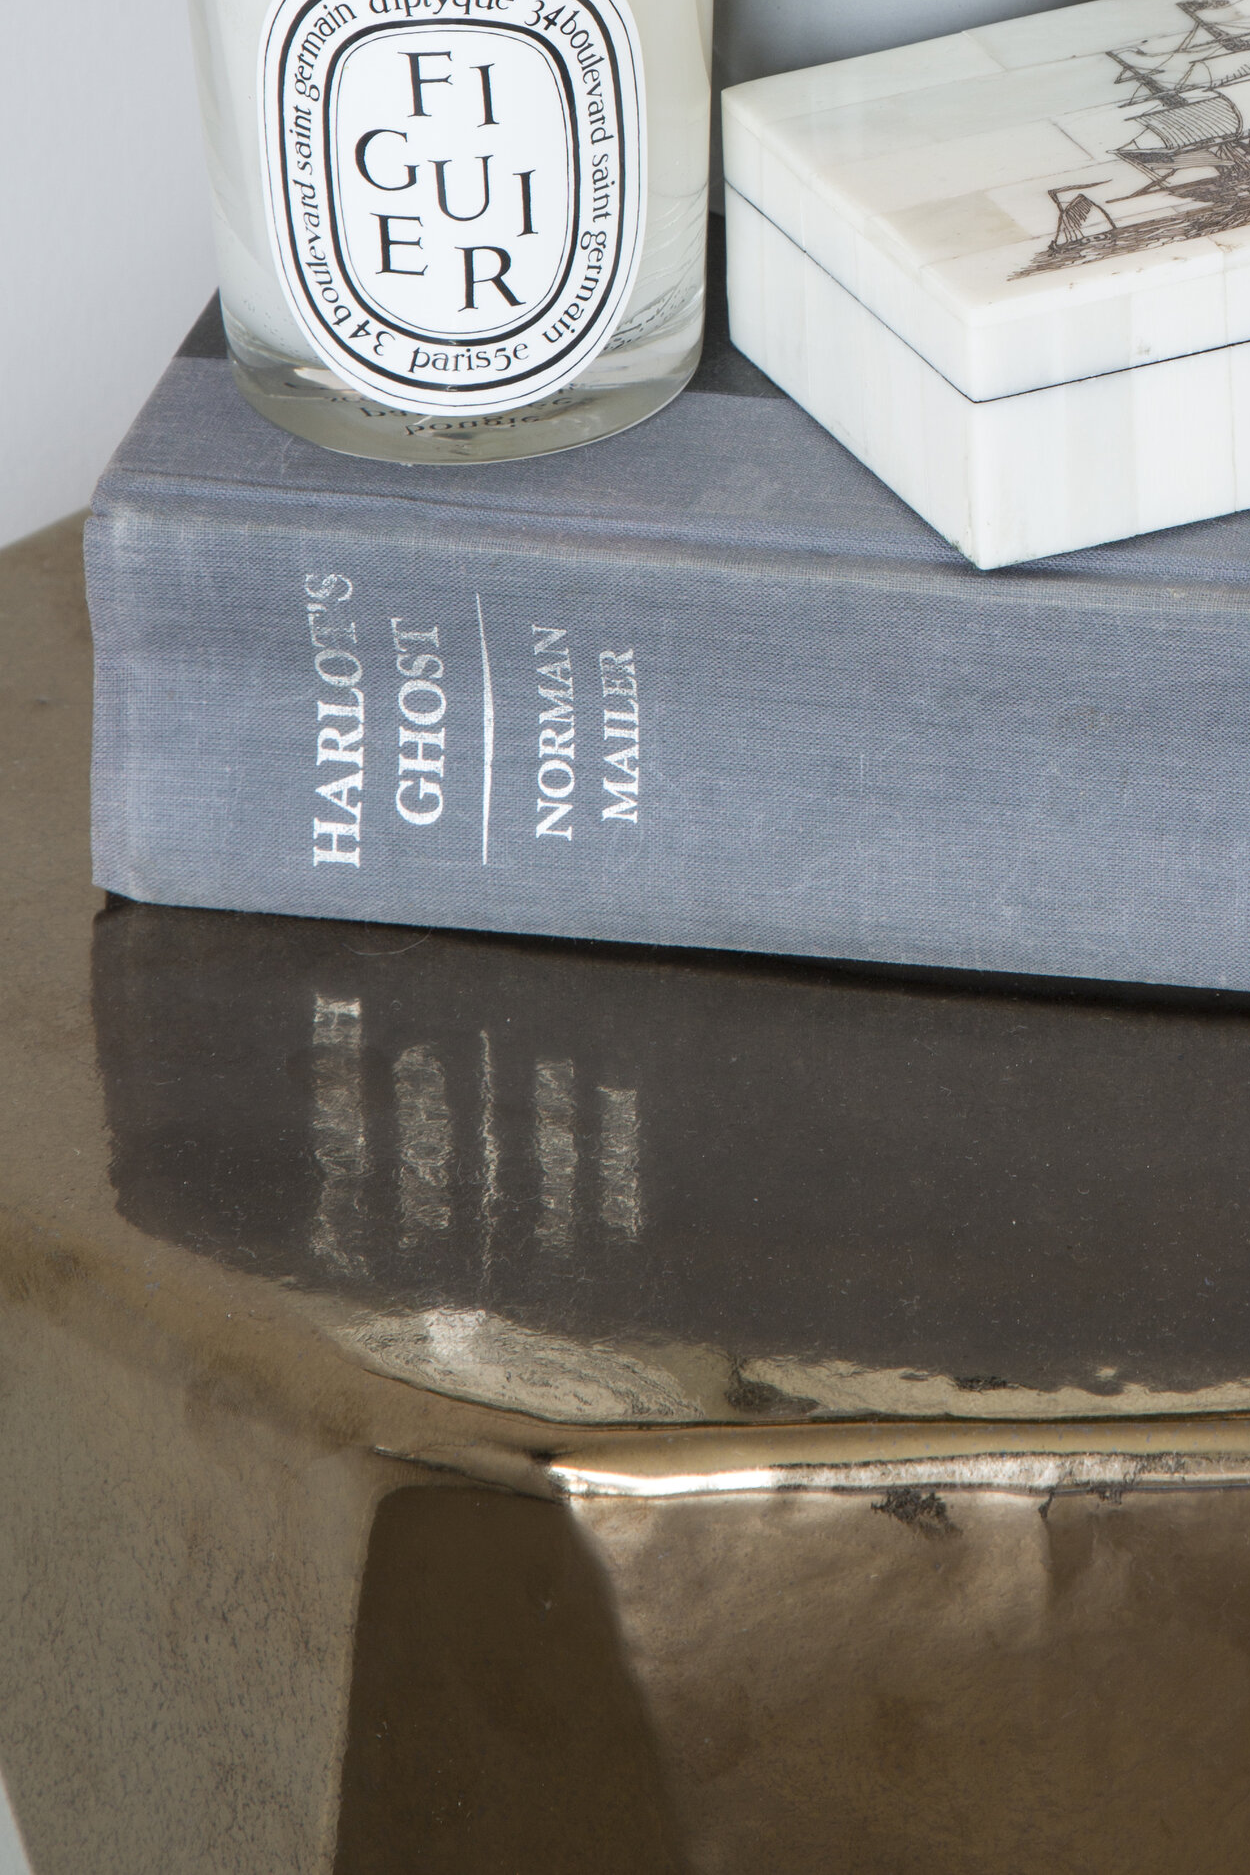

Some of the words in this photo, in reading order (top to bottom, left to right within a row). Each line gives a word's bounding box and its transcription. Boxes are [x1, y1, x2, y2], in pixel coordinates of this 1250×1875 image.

[293, 2, 358, 103] germain
[289, 105, 313, 175] saint
[591, 153, 616, 223] saint
[541, 229, 607, 345] germain
[303, 573, 365, 869] HARLOT'S
[390, 617, 447, 826] GHOST
[531, 624, 576, 842] NORMAN
[599, 648, 640, 824] MAILER
